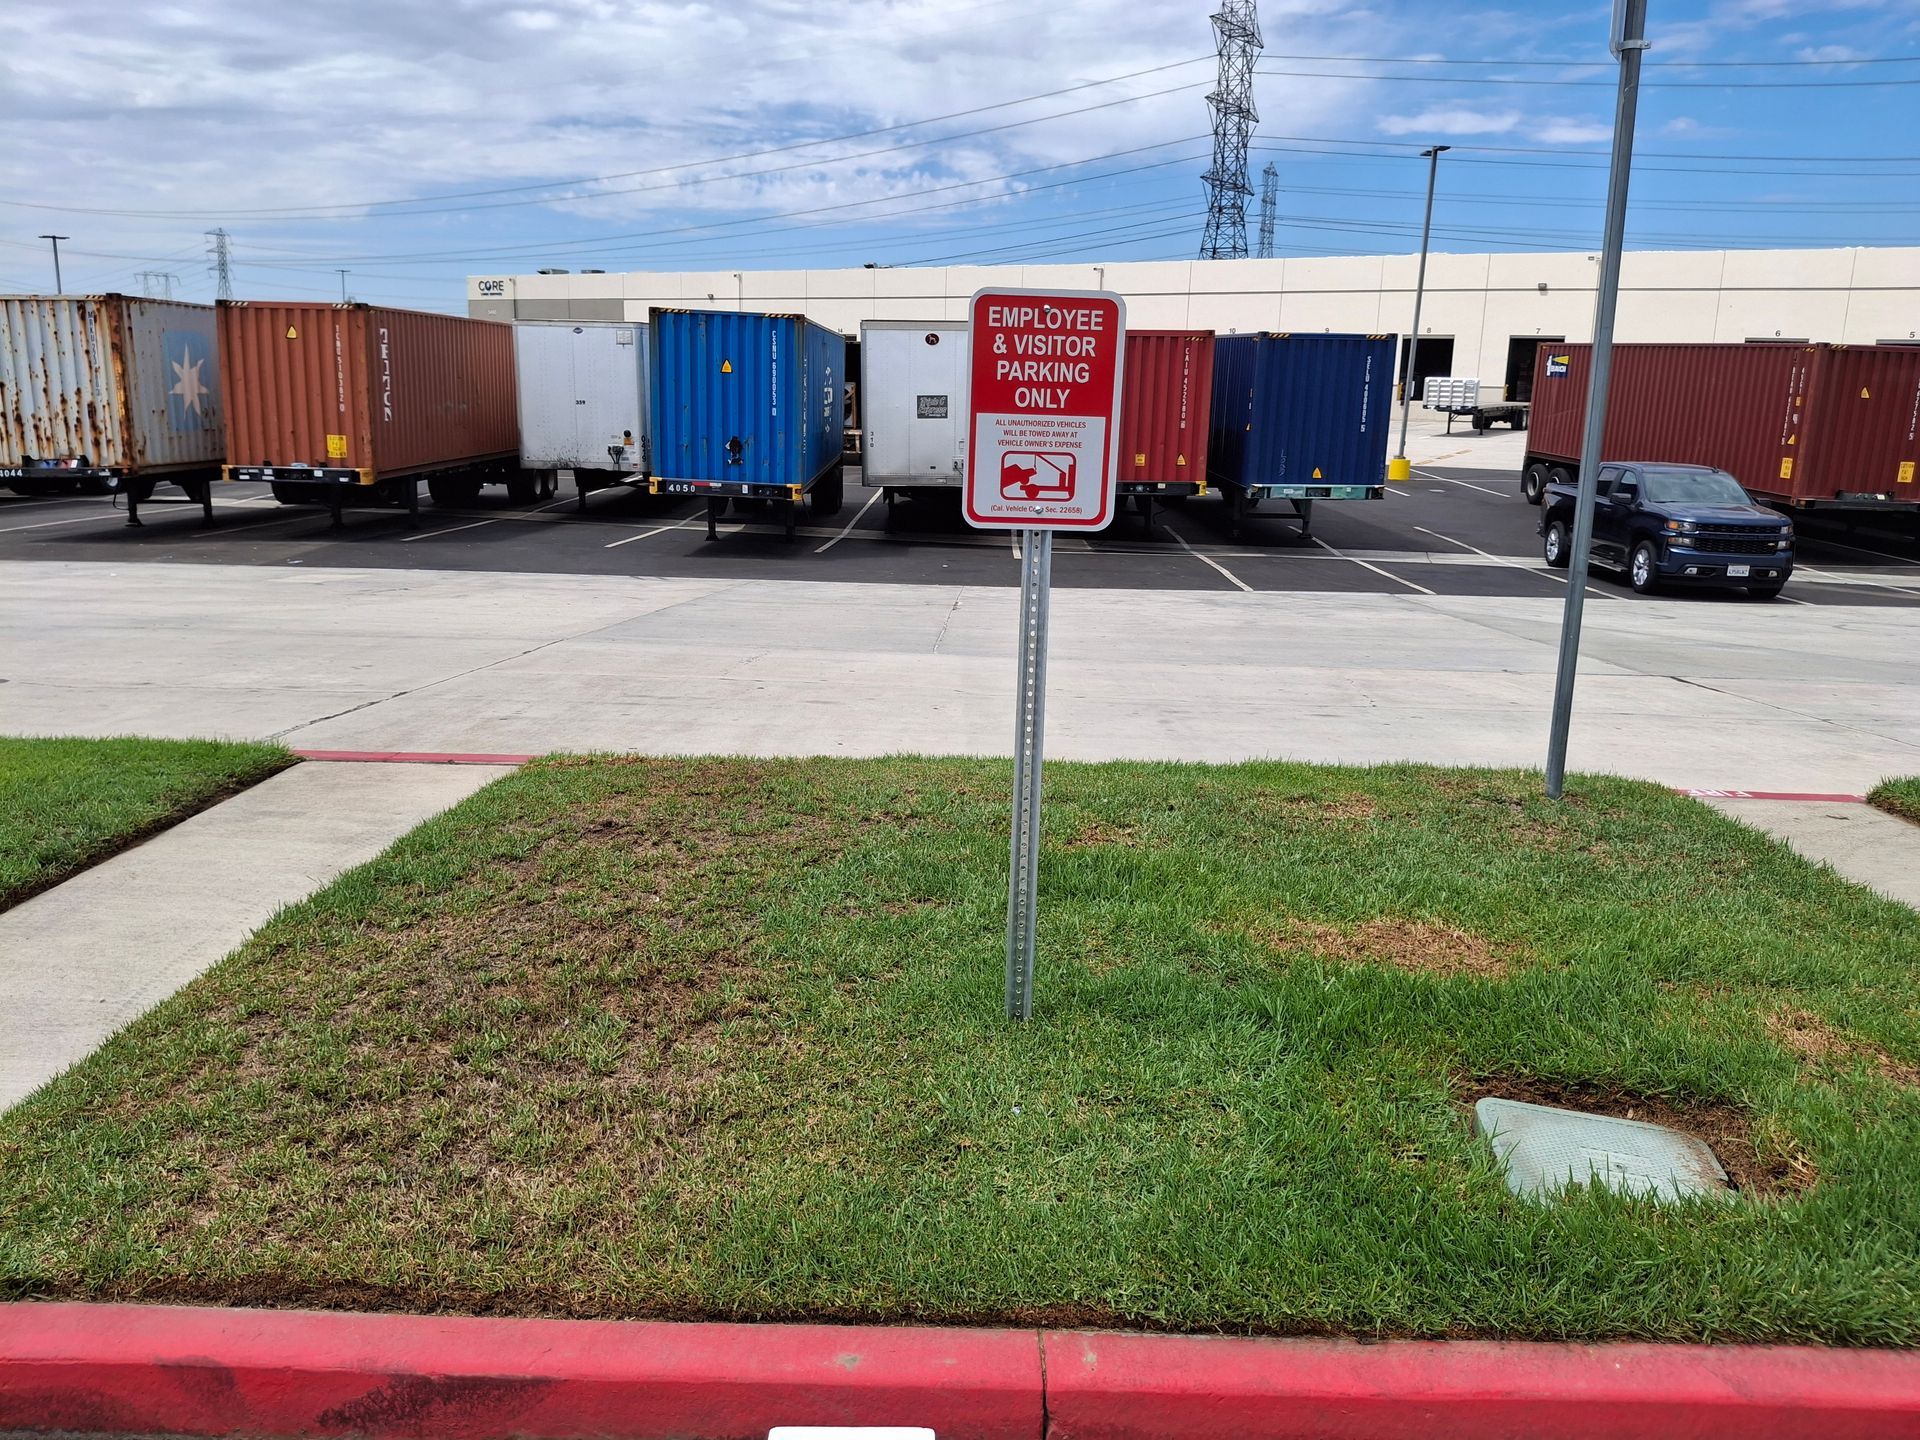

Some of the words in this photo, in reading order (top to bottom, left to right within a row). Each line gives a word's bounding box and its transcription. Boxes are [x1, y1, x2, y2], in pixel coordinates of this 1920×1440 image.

[478, 280, 504, 291] CORE
[988, 306, 1104, 331] EMPLOYEE
[993, 333, 1007, 354] &
[1014, 334, 1096, 357] VISITOR
[996, 360, 1090, 383] PARKING
[1015, 387, 1070, 408] ONLY
[0, 469, 23, 477] 4044
[669, 484, 696, 492] 4050
